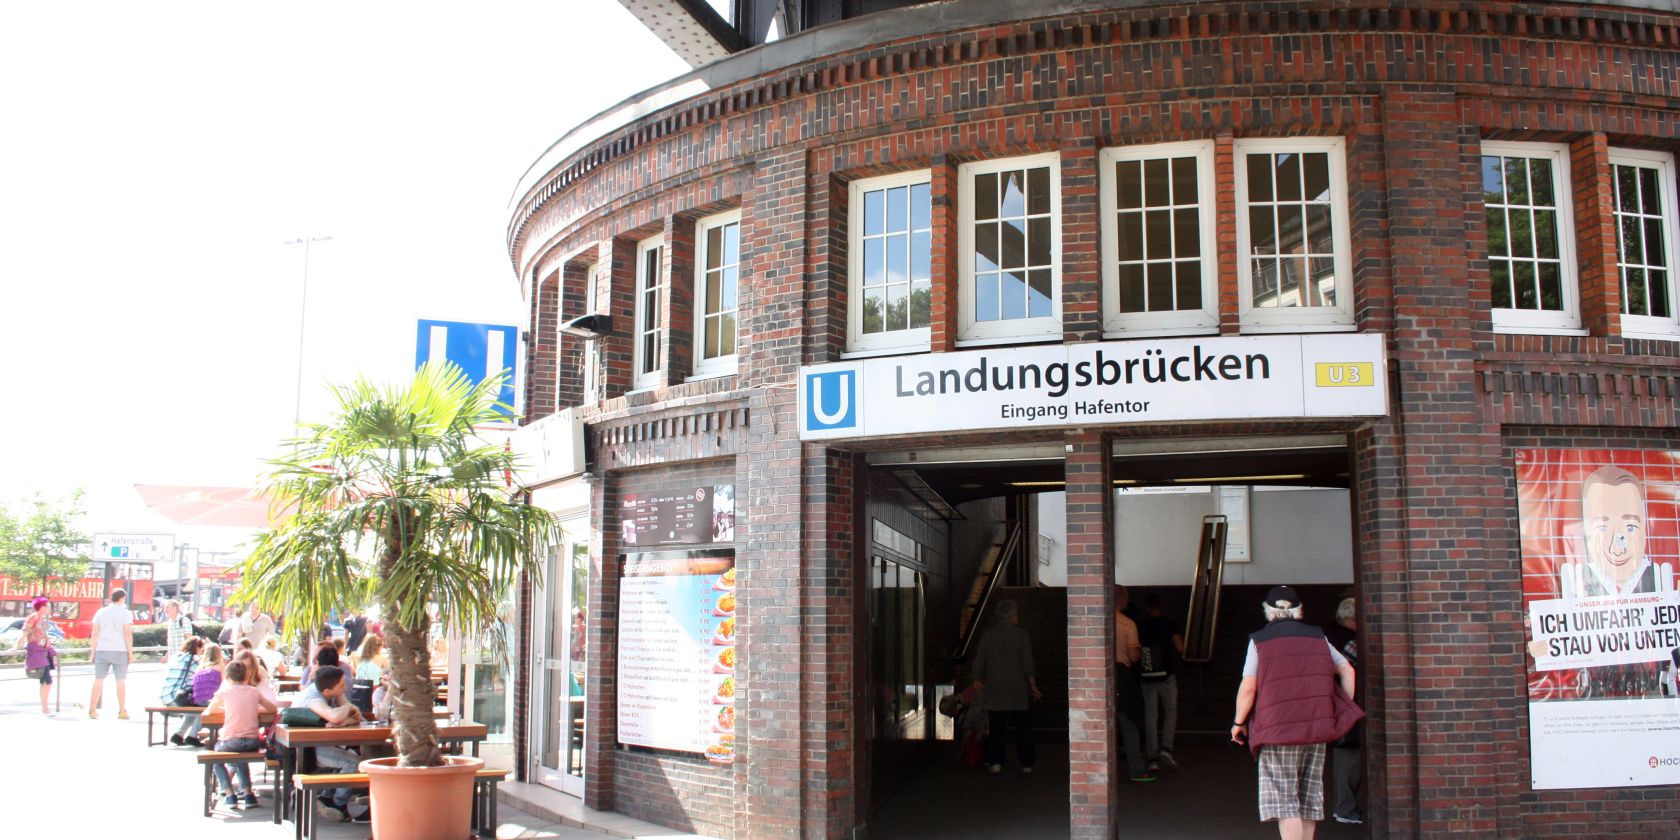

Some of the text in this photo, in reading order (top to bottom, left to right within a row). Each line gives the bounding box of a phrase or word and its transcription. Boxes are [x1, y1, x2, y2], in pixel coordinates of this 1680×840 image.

[895, 345, 1270, 398] Landungsbrücken
[813, 374, 849, 425] U
[1001, 399, 1150, 421] Eingang Hafentor
[111, 536, 154, 545] Hafenstraße
[1616, 597, 1629, 605] FÜR
[1629, 596, 1660, 605] HAMBURG
[1539, 613, 1568, 634] ICH
[1549, 636, 1592, 657] STAU
[1596, 631, 1630, 654] VON
[1660, 757, 1680, 766] HOC
